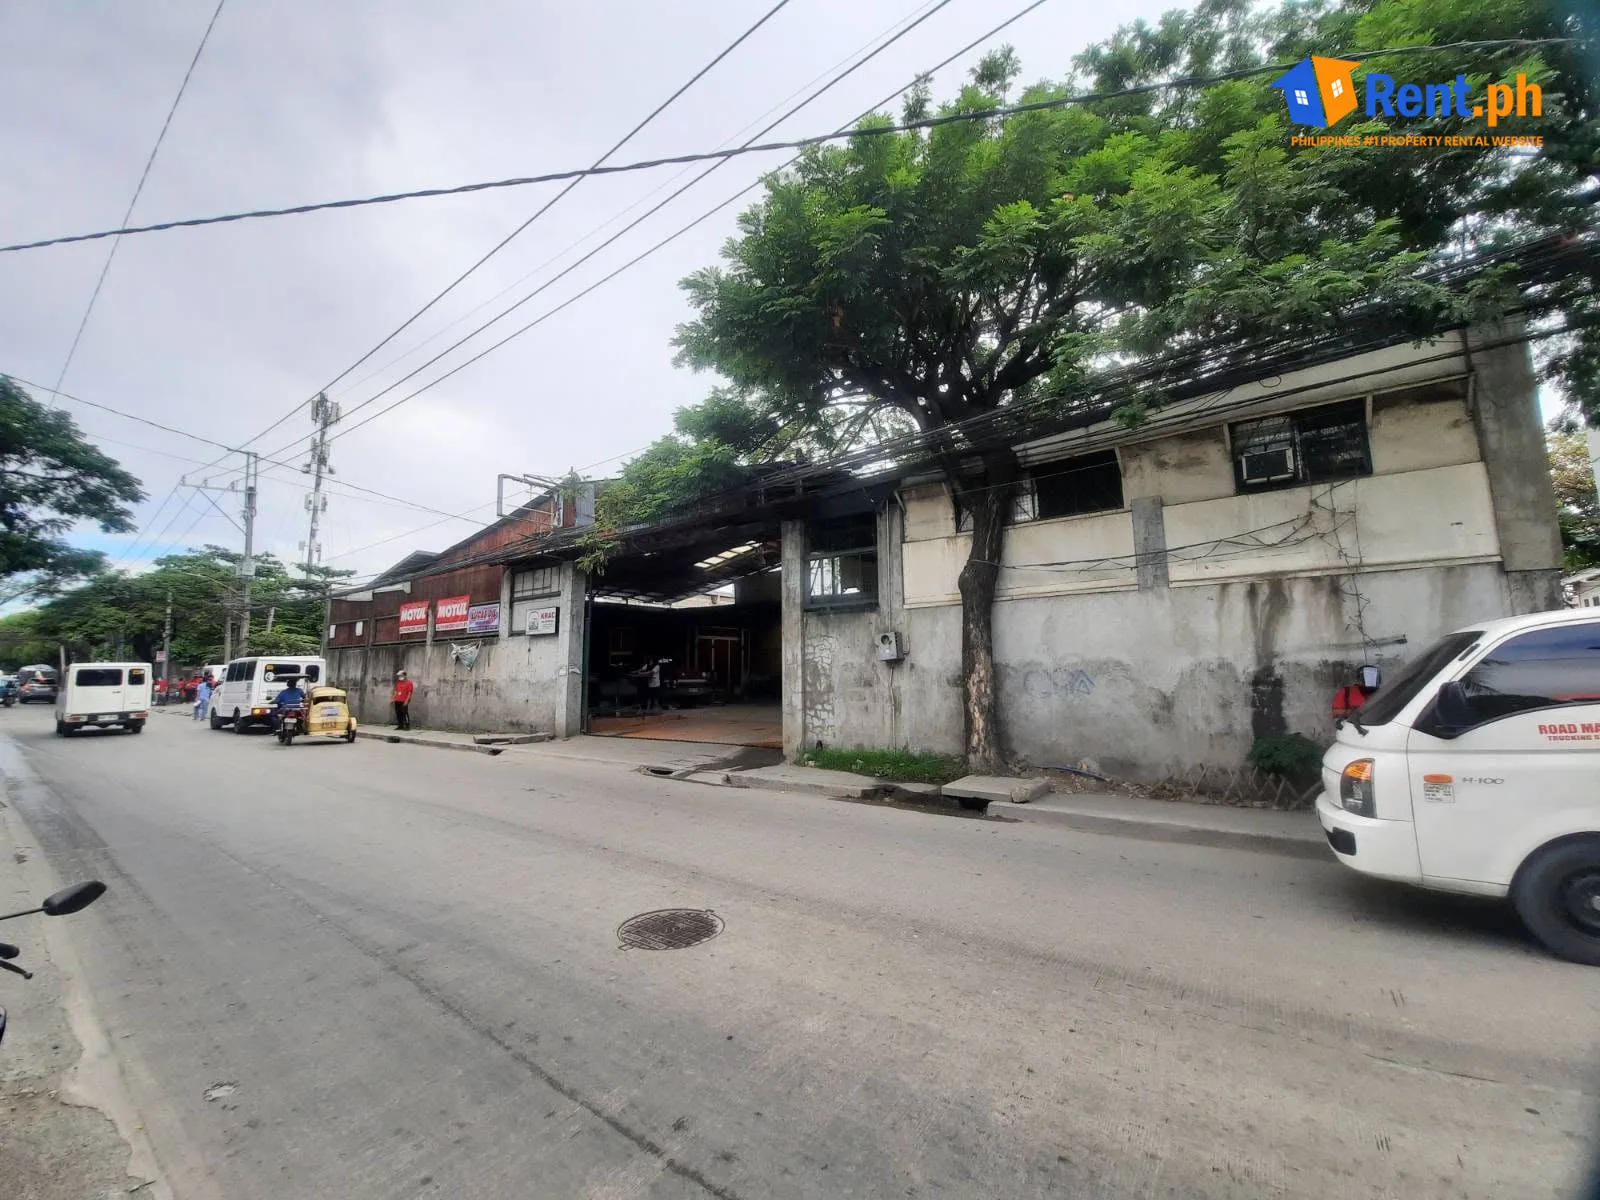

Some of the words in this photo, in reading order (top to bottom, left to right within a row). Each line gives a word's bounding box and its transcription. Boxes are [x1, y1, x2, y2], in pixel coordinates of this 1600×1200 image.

[400, 607, 427, 621] MOTUL
[437, 602, 468, 618] MOTUL
[1538, 723, 1577, 735] ROAD
